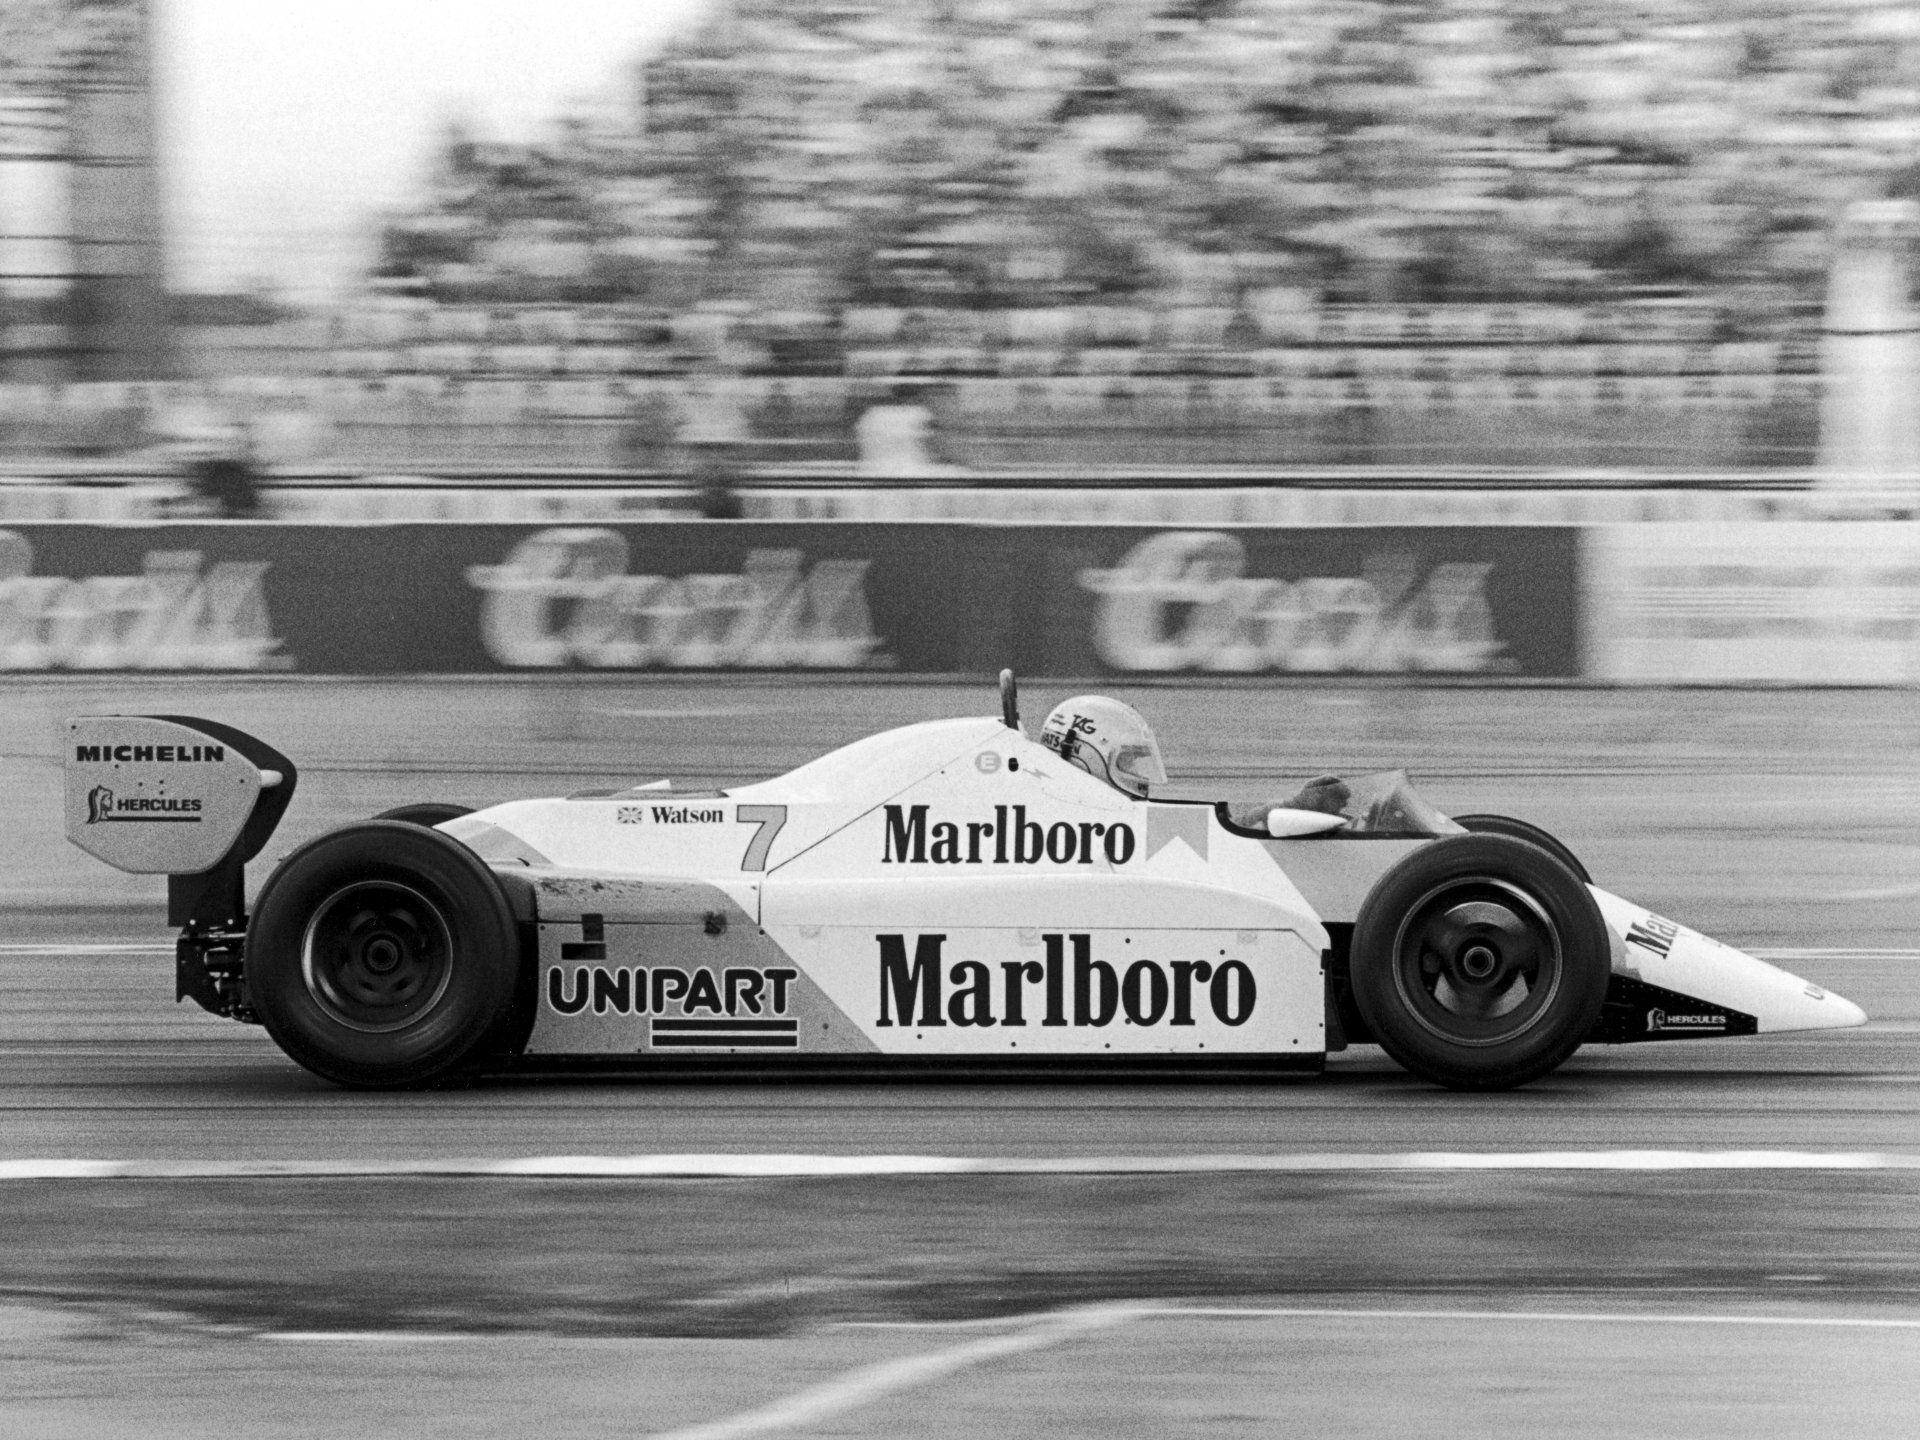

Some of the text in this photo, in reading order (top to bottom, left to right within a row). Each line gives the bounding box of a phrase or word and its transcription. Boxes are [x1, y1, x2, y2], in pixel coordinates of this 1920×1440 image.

[1071, 714, 1096, 735] TAG
[76, 745, 224, 762] MICHELIN
[117, 798, 202, 812] HERCULES
[651, 806, 724, 824] Watson
[736, 804, 788, 872] 7
[881, 804, 1136, 865] Marlboro
[548, 966, 798, 1016] UNIPART
[875, 934, 1257, 1027] Marlboro
[1667, 1014, 1727, 1025] HERCULES
